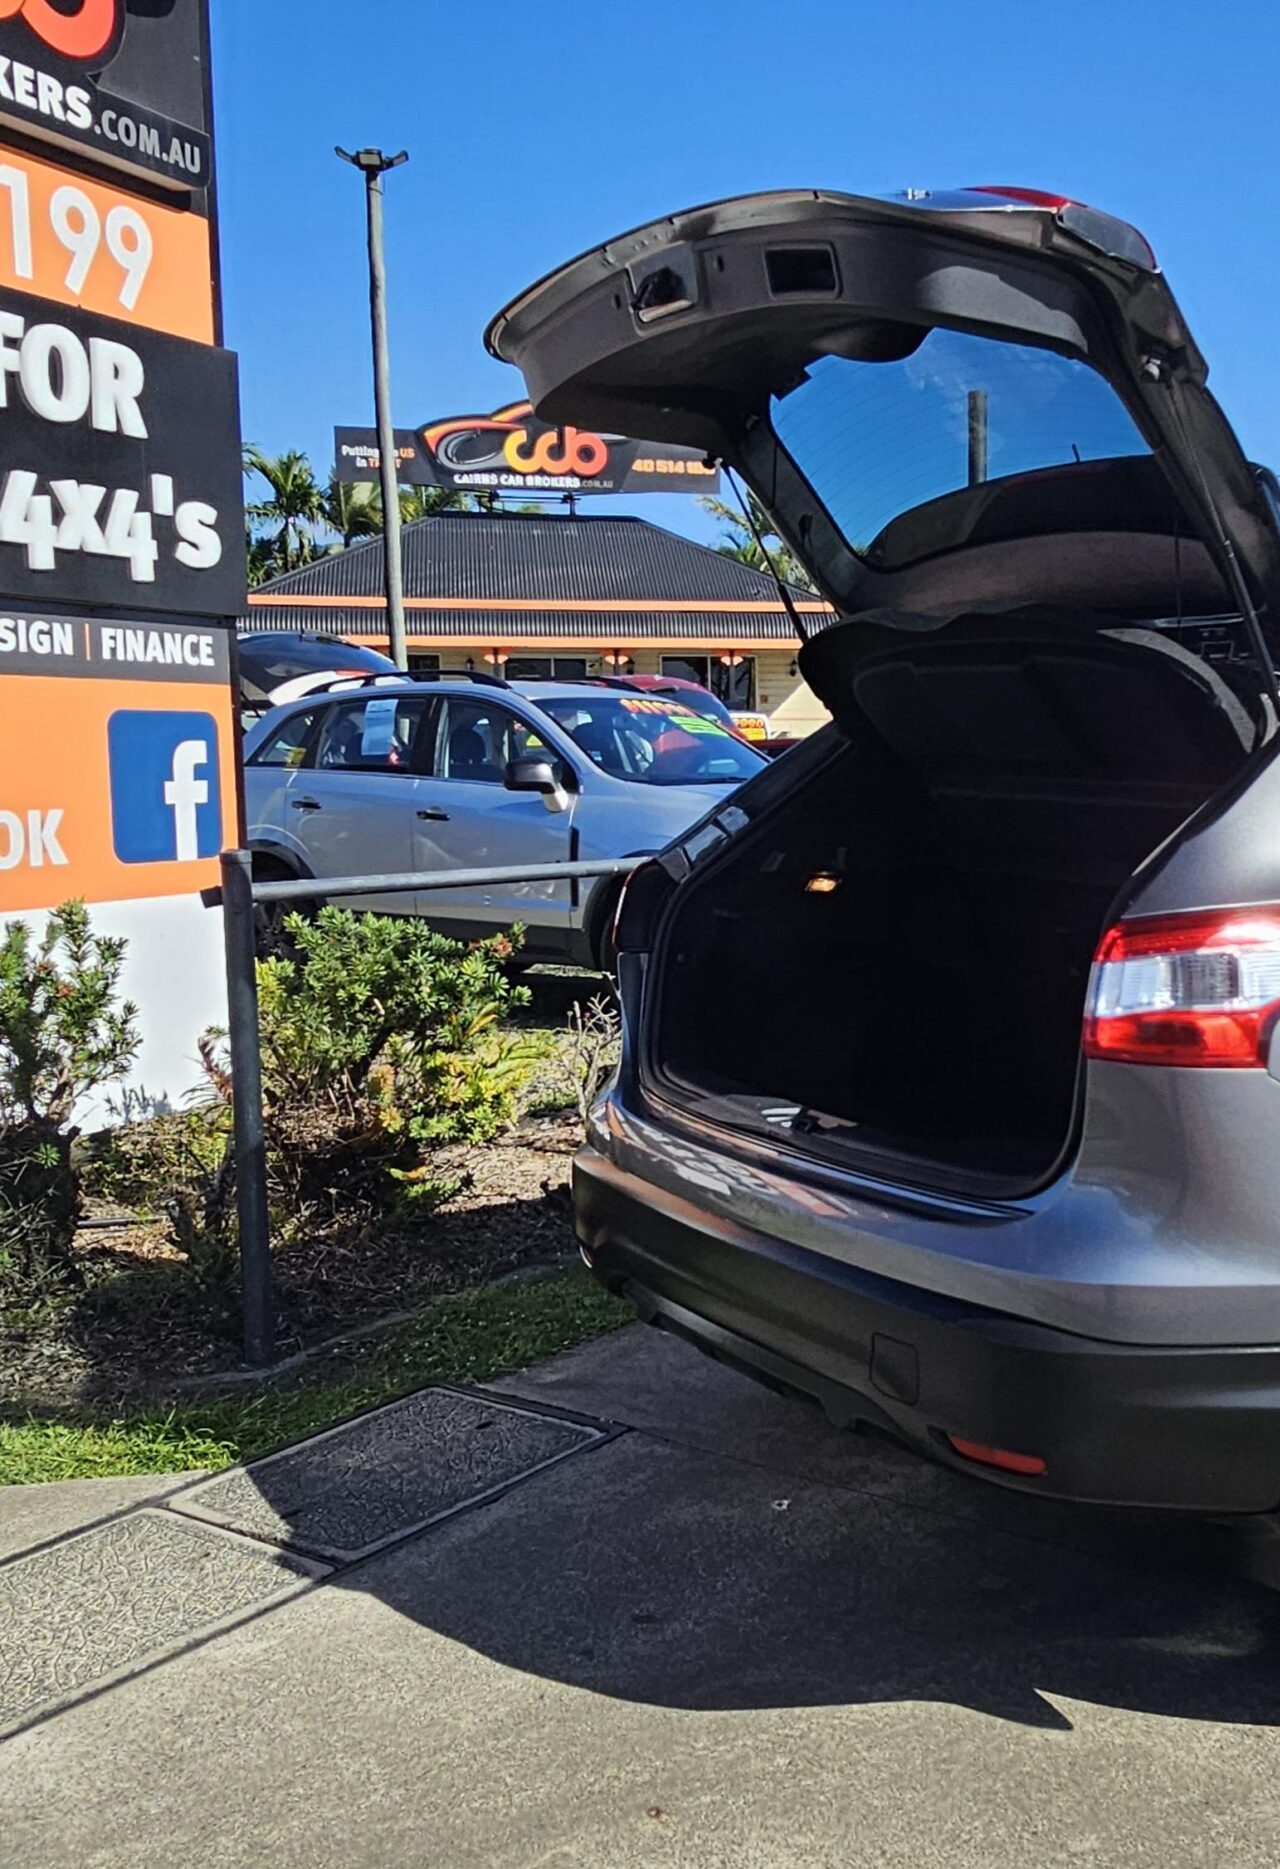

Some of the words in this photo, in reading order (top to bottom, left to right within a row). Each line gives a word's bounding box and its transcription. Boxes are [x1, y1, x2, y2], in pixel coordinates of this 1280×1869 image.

[0, 310, 148, 439] FOR
[399, 447, 416, 459] US
[631, 458, 655, 473] 40
[655, 459, 685, 474] 514
[453, 474, 498, 485] CAIRNS
[500, 474, 523, 486] CAR
[0, 617, 74, 656] SIGN
[101, 627, 215, 666] FINANCE
[164, 740, 208, 861] f
